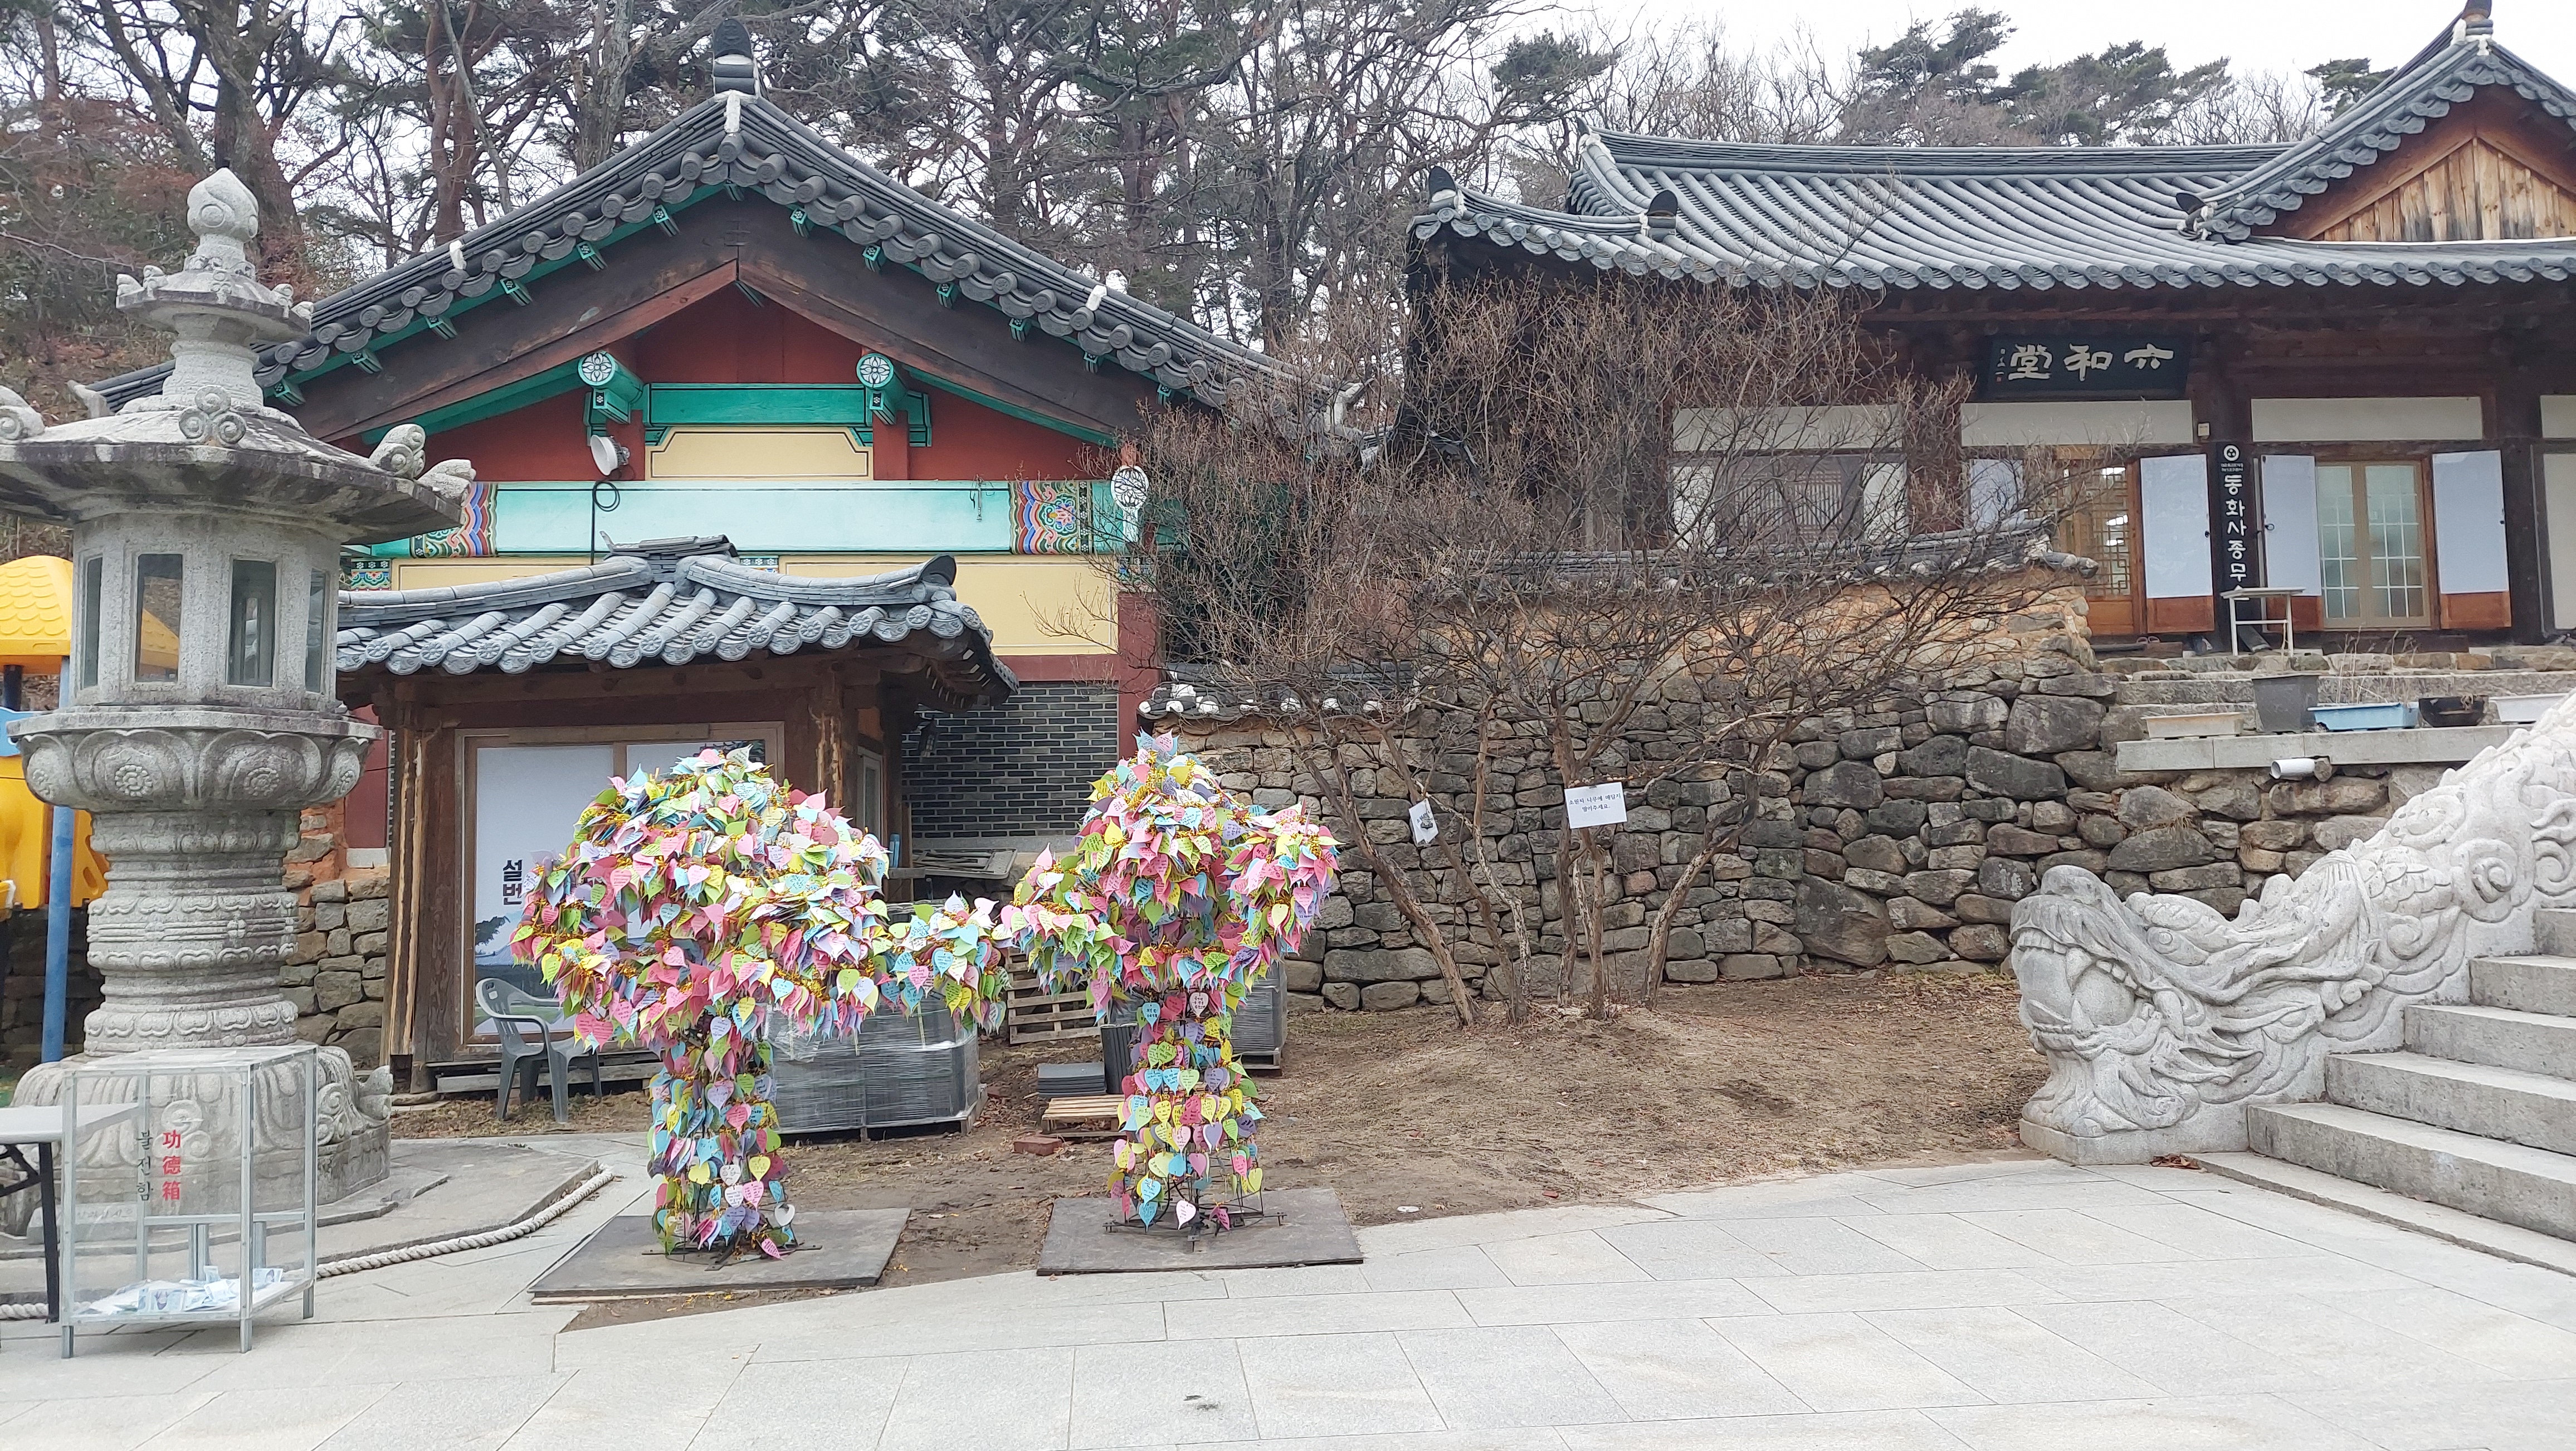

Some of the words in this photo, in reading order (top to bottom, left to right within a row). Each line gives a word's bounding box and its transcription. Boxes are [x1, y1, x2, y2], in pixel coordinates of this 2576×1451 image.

[2224, 474, 2247, 590] 동화사종무
[136, 1129, 153, 1201] 불전함
[162, 1129, 182, 1201] 功德箱
